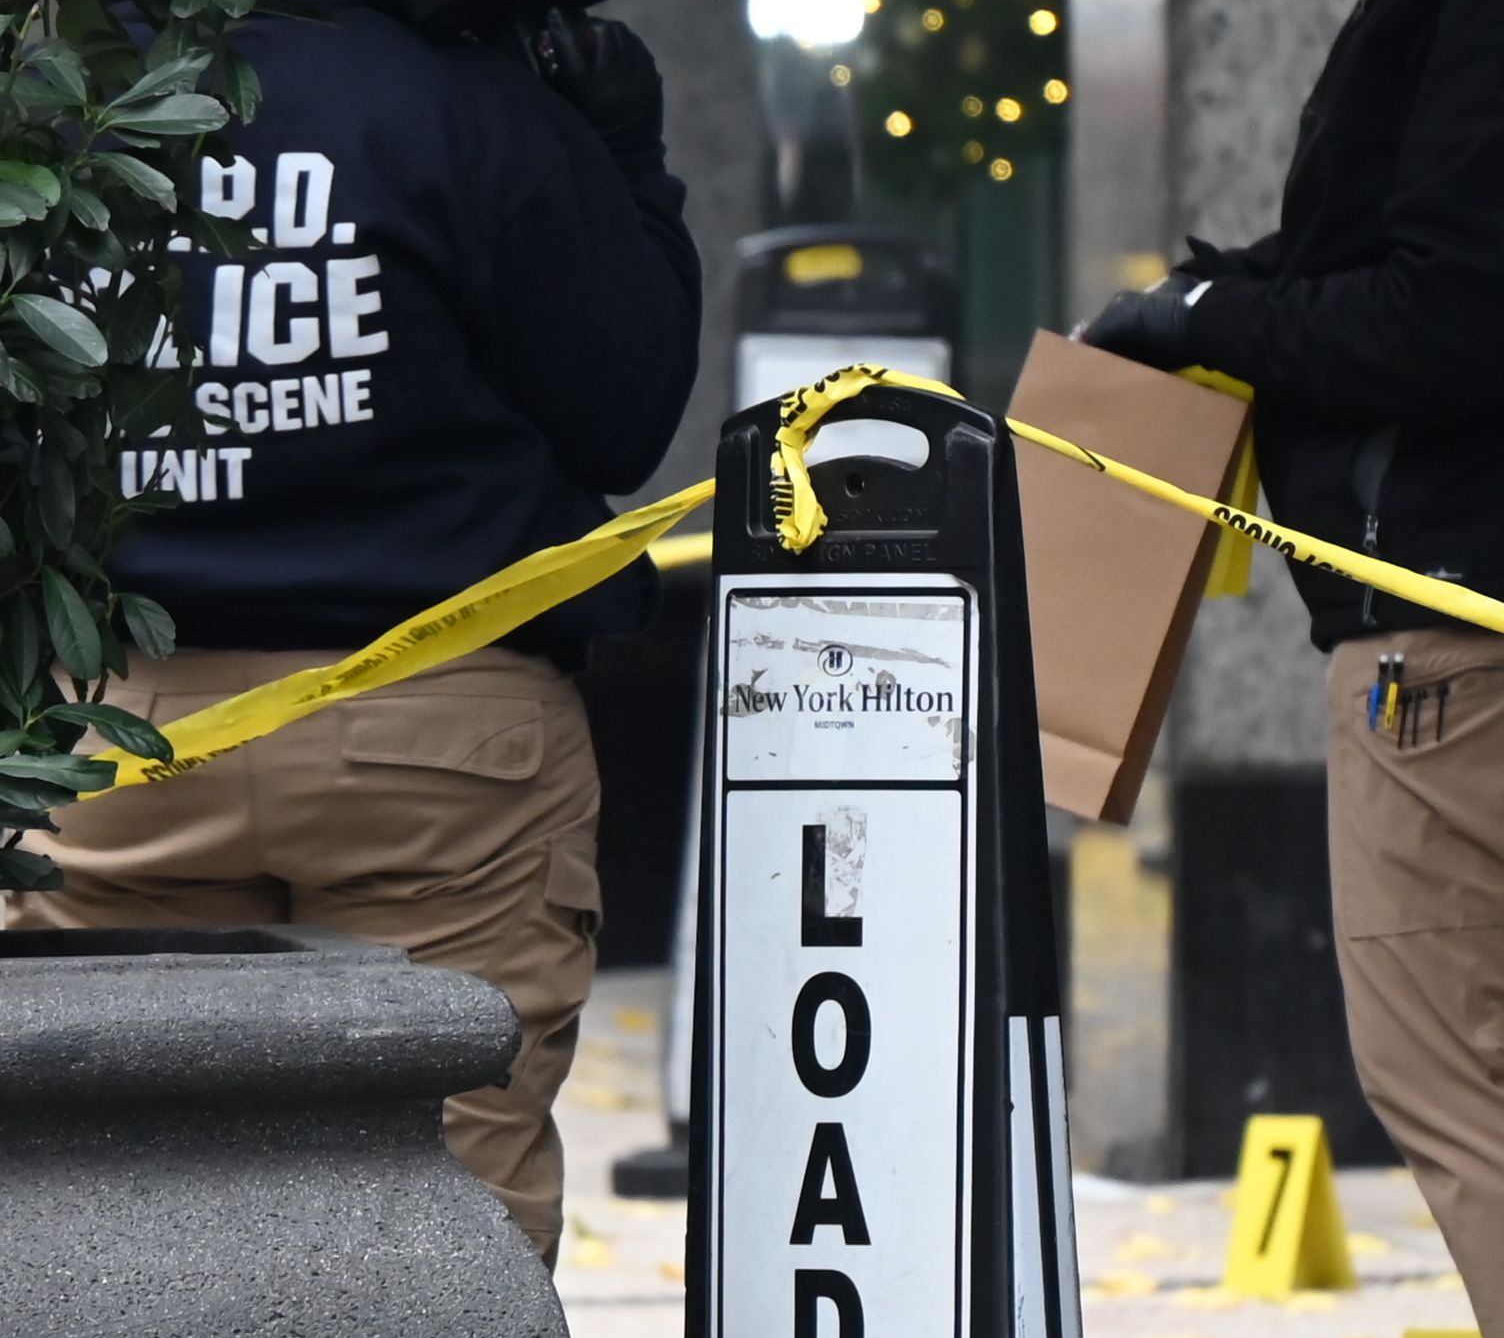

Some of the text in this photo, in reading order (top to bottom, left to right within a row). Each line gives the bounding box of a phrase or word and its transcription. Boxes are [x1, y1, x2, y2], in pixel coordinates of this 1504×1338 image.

[146, 255, 389, 368] ICE
[195, 369, 374, 435] SCENE
[120, 447, 252, 503] UNIT
[735, 684, 954, 712] New York Hilton
[814, 720, 855, 730] MIDTOWN
[1258, 1148, 1293, 1255] 7
